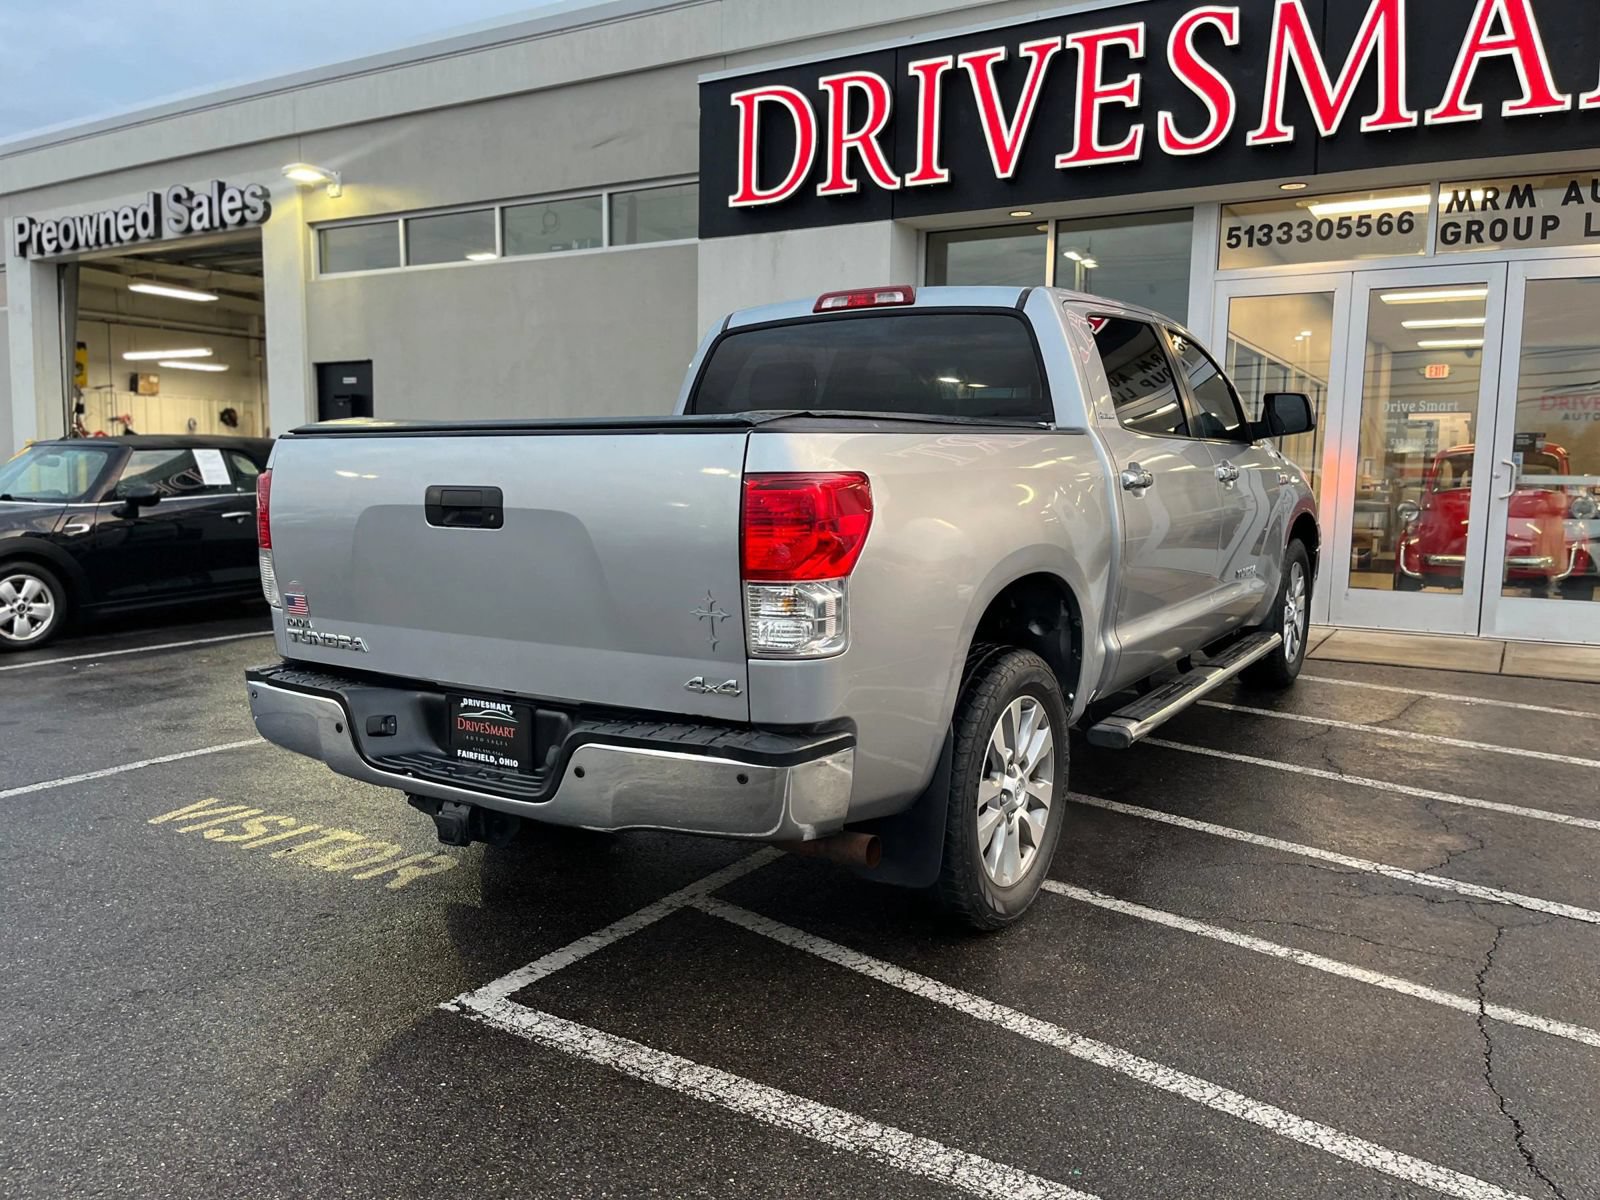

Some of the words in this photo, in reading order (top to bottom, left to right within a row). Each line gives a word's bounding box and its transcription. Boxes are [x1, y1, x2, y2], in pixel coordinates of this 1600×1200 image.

[728, 0, 1600, 207] DRIVESMA
[1445, 184, 1536, 214] MRM
[13, 192, 160, 257] Preowned
[167, 179, 270, 234] Sales
[1226, 211, 1415, 249] 5133305566
[1440, 215, 1560, 245] GROUP
[1384, 400, 1416, 413] Drive
[1418, 400, 1458, 413] Smart
[286, 628, 369, 653] TUNDRA
[683, 676, 743, 697] 4x4
[462, 697, 512, 712] DRIVESMART
[457, 749, 497, 765] FAIRFIELD,
[499, 757, 519, 768] OHIO
[148, 797, 459, 889] VISITOR
